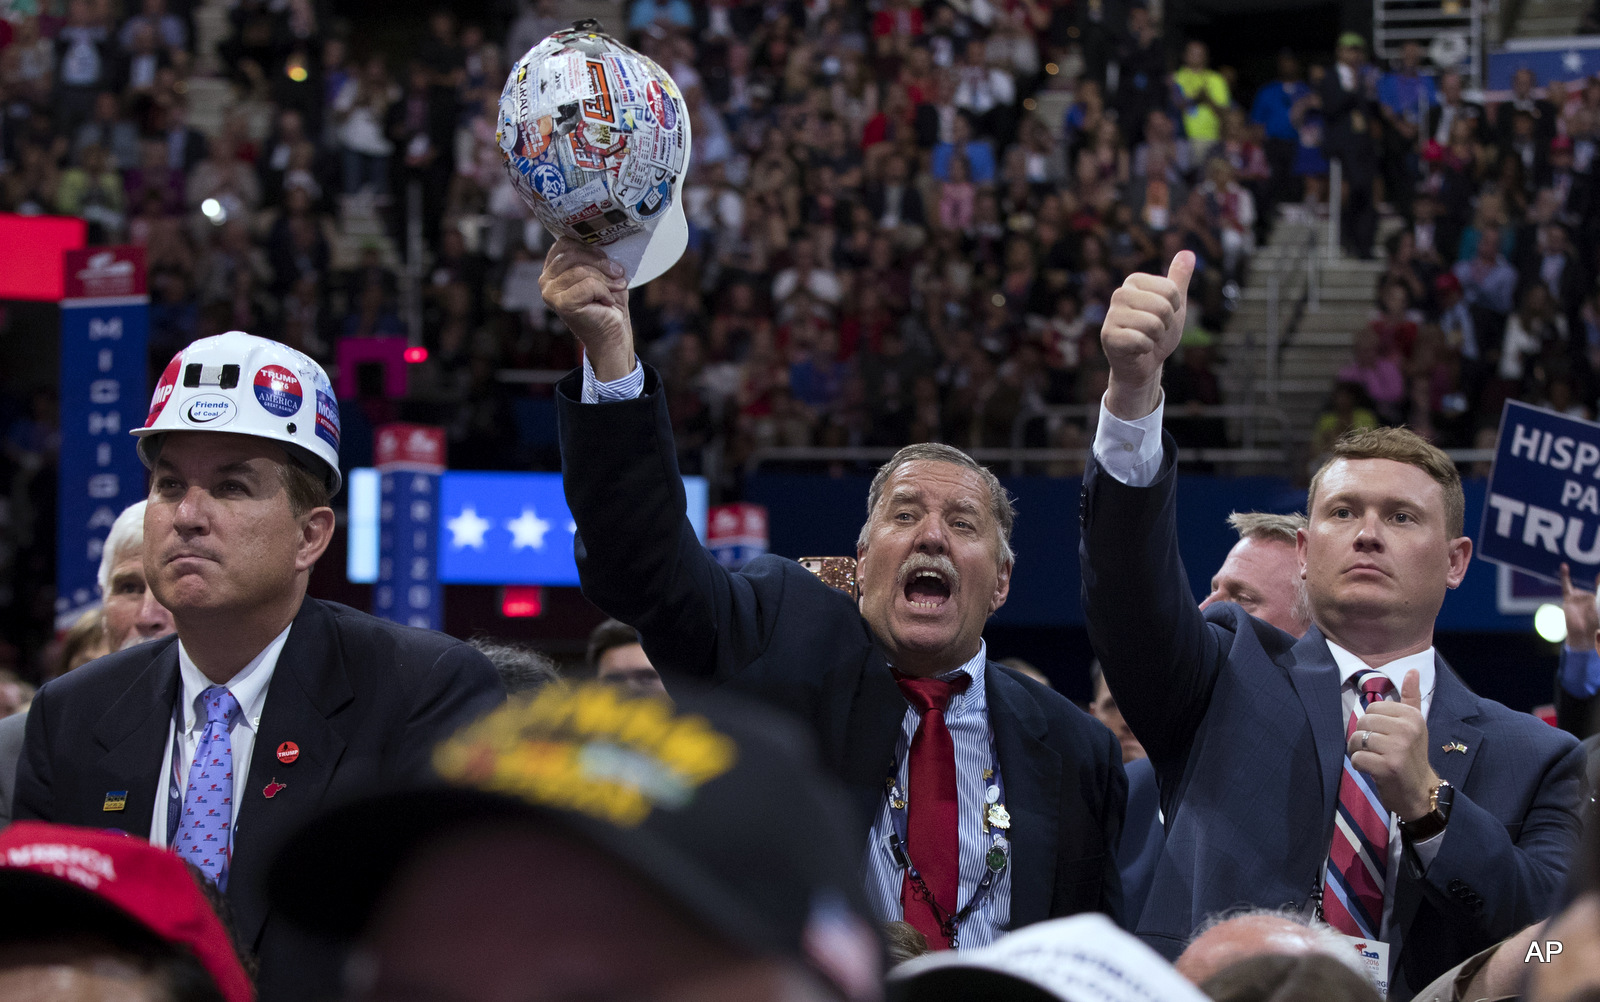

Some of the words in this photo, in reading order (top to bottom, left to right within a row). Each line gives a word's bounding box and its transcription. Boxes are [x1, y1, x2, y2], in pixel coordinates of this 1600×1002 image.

[260, 369, 298, 384] TRUMP
[195, 401, 229, 409] Friends
[258, 392, 298, 410] AMERICA
[1510, 424, 1600, 480] HISP
[1490, 493, 1600, 565] TRU
[277, 749, 299, 758] TRUMP
